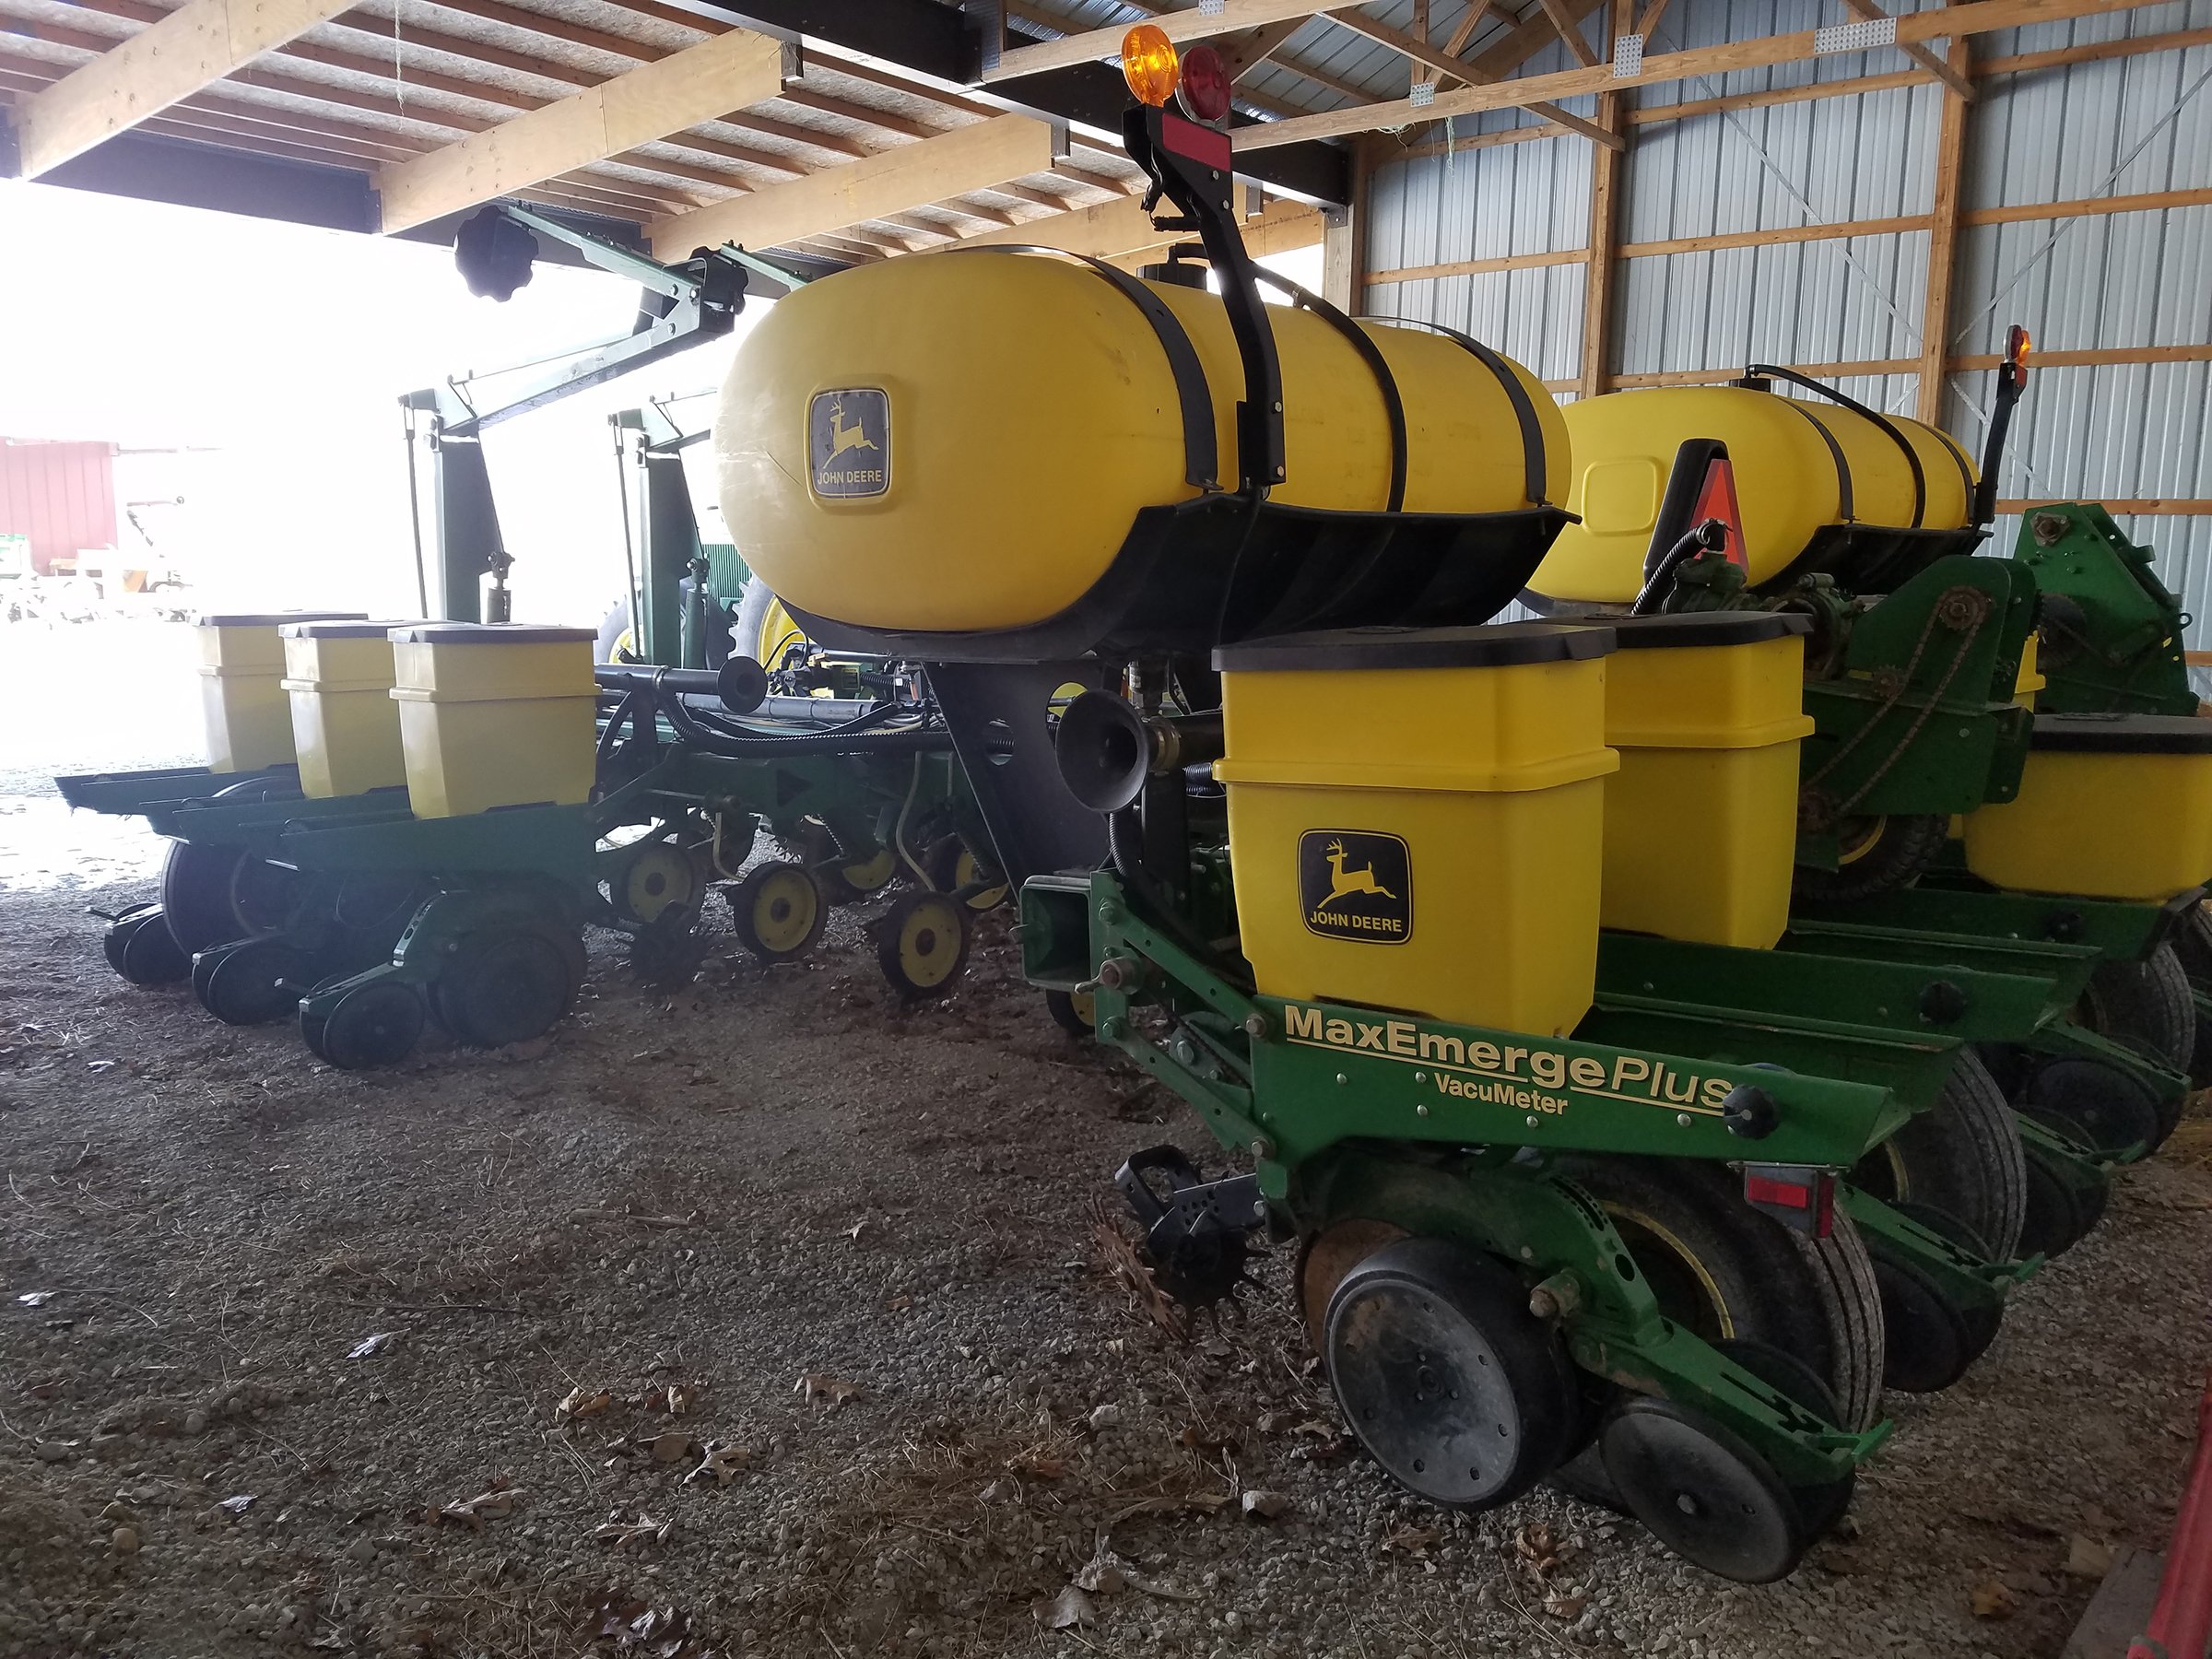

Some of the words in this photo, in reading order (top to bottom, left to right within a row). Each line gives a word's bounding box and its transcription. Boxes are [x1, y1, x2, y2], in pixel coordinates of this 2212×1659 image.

[818, 472, 844, 485] JOHN
[847, 469, 882, 483] DEERE
[1310, 911, 1348, 927] JOHN
[1352, 915, 1402, 933] DEERE
[1434, 1072, 1569, 1115] VacuMeter
